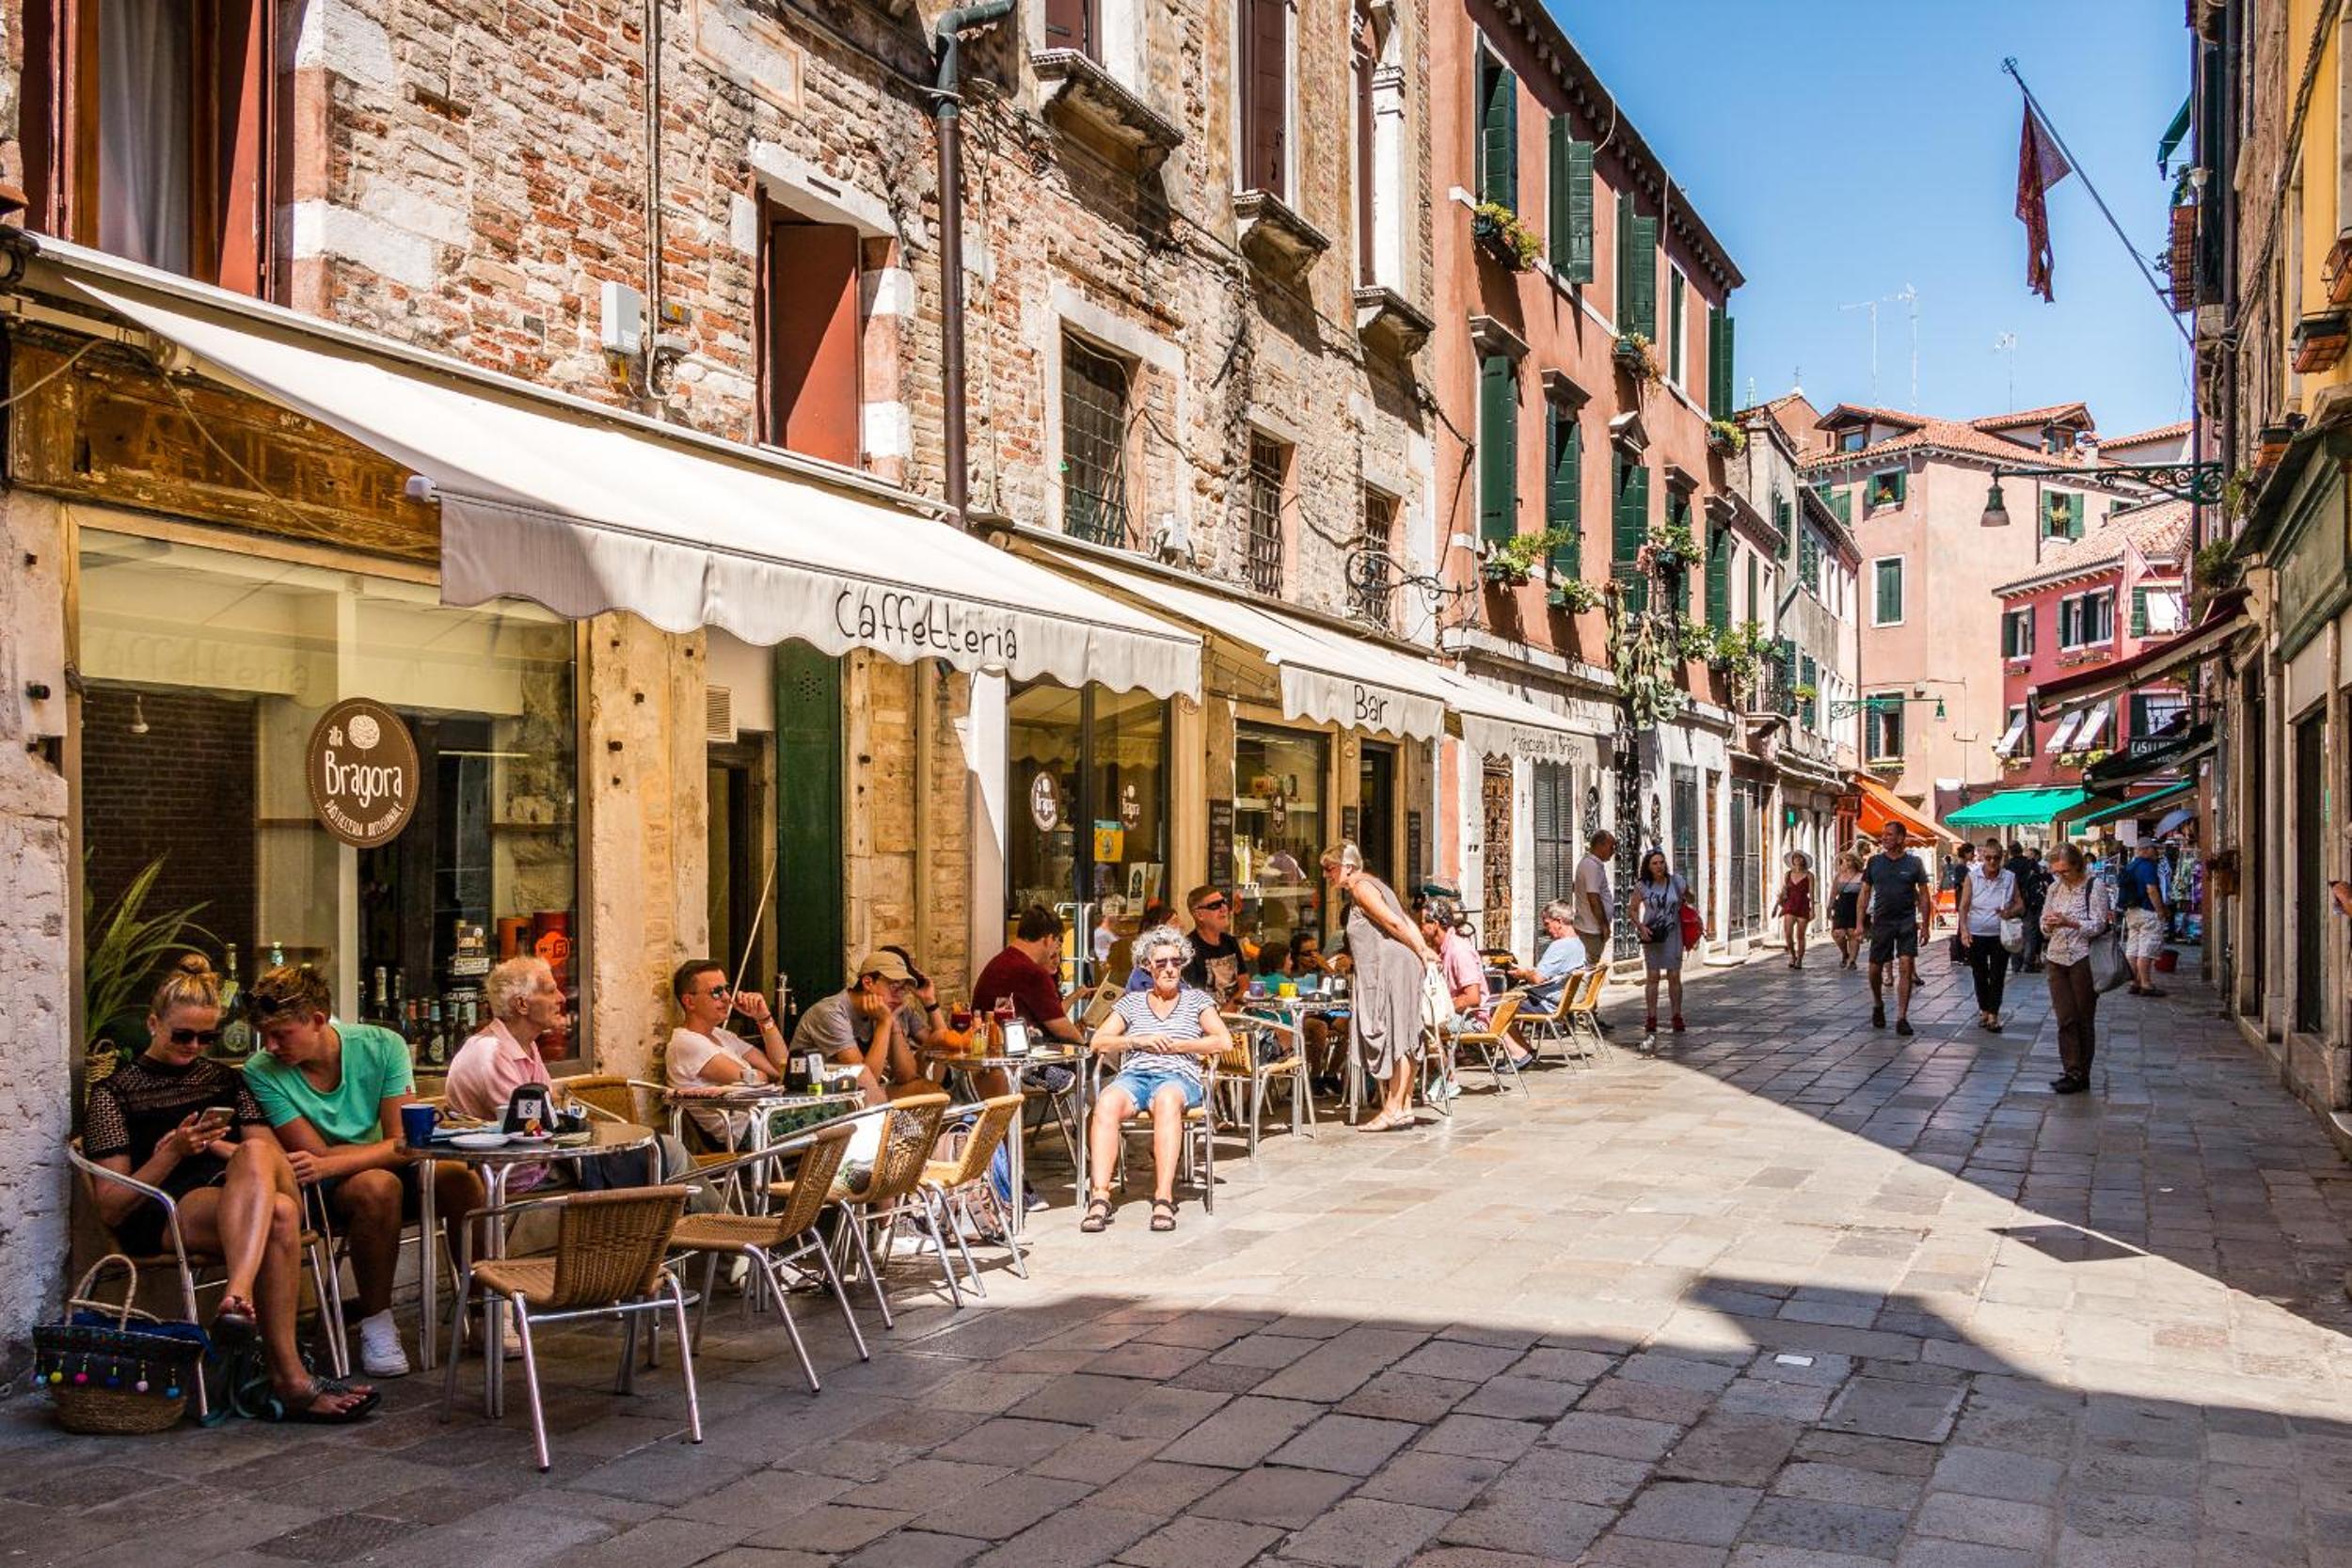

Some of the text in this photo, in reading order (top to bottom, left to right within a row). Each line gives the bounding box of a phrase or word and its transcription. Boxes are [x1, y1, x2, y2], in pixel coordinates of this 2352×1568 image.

[834, 589, 1018, 660] Caffetteria
[1353, 684, 1389, 724] Bar
[325, 750, 403, 809] Bragora
